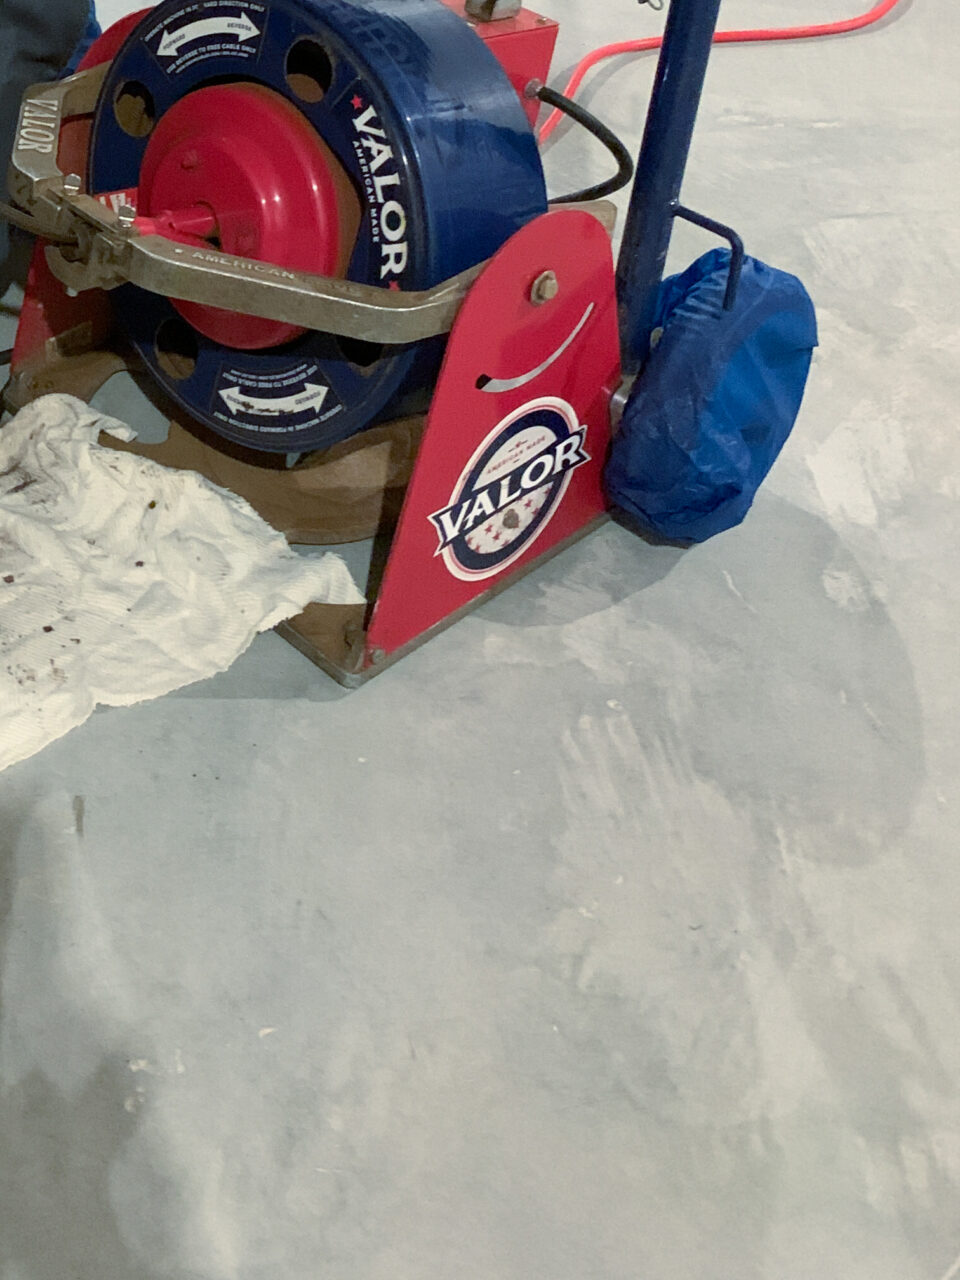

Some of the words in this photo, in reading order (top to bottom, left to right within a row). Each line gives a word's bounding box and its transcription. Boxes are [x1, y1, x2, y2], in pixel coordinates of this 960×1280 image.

[219, 0, 249, 8] DIRECTION
[250, 2, 265, 12] ONLY
[18, 99, 58, 153] VALOR
[351, 140, 377, 204] AMERICAN
[370, 208, 380, 243] MADE
[351, 104, 409, 280] VALOR
[192, 251, 295, 280] AMERICAN
[440, 434, 581, 542] VALOR
